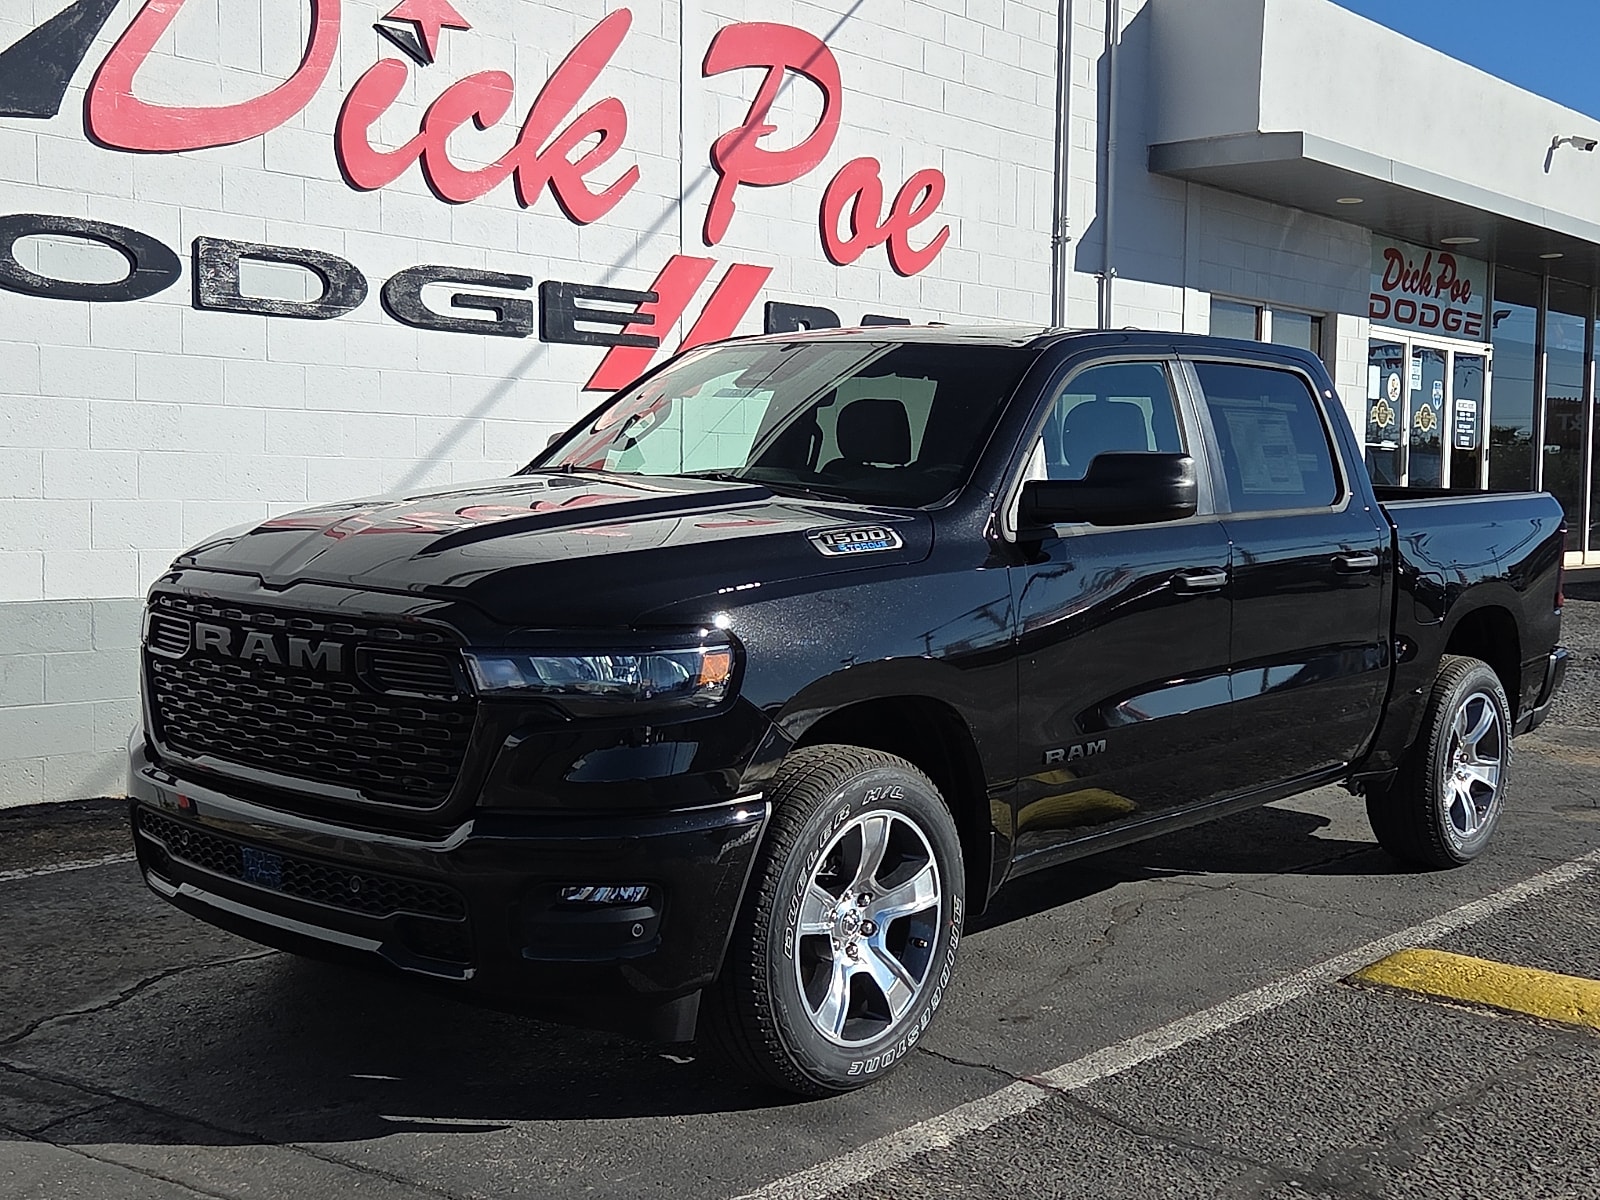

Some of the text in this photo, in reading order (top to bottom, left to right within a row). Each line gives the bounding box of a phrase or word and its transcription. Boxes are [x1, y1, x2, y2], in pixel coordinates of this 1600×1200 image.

[702, 22, 951, 277] Poe
[1382, 247, 1472, 304] Dick Poe
[1369, 293, 1482, 336] DODGE
[823, 529, 887, 545] 1500
[195, 621, 344, 673] RAM
[1045, 739, 1107, 765] RAM
[847, 894, 963, 1076] BRIDGESTONE
